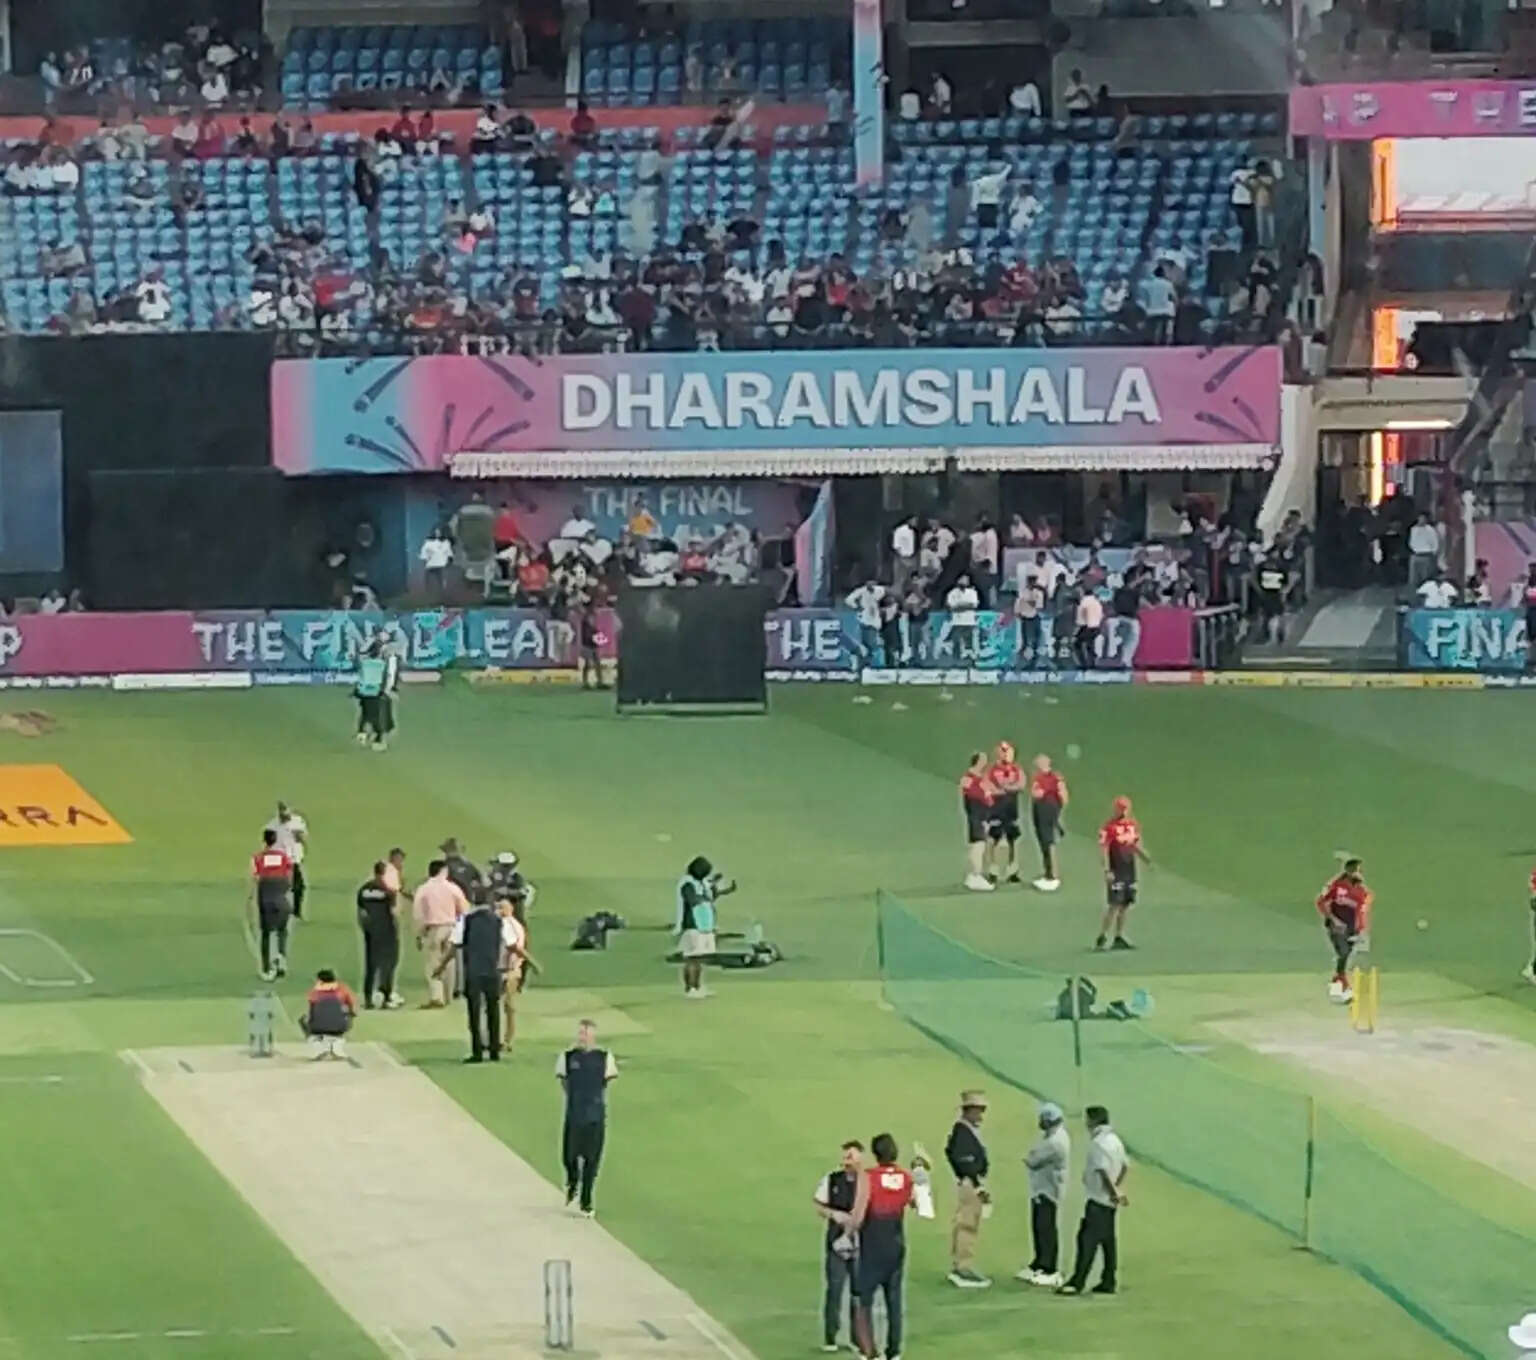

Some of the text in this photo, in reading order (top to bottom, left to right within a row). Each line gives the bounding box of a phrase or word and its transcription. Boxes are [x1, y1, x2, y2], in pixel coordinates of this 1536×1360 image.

[562, 366, 1163, 430] DHARAMSHALA
[660, 485, 754, 517] FINAL
[191, 621, 285, 663] THE
